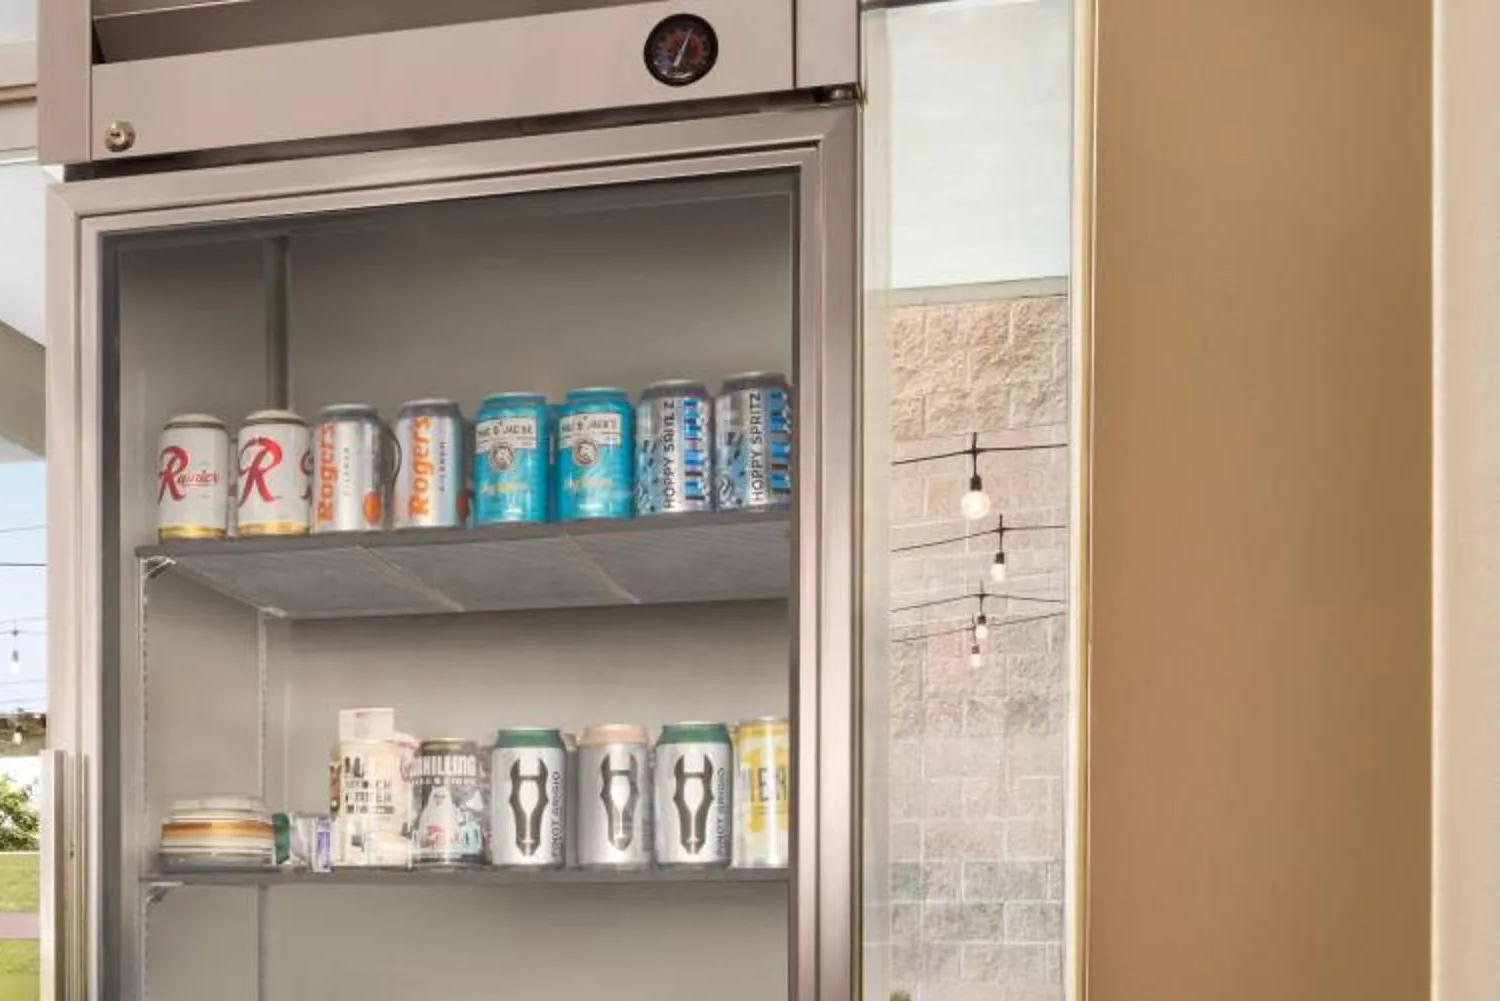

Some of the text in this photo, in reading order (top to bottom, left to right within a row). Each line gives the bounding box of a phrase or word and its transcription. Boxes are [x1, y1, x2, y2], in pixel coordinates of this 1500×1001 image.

[318, 422, 339, 523] Rogers
[408, 415, 436, 517] Rogers
[663, 461, 676, 509] HOPPY
[750, 392, 763, 502] HOPPY SPRITZ
